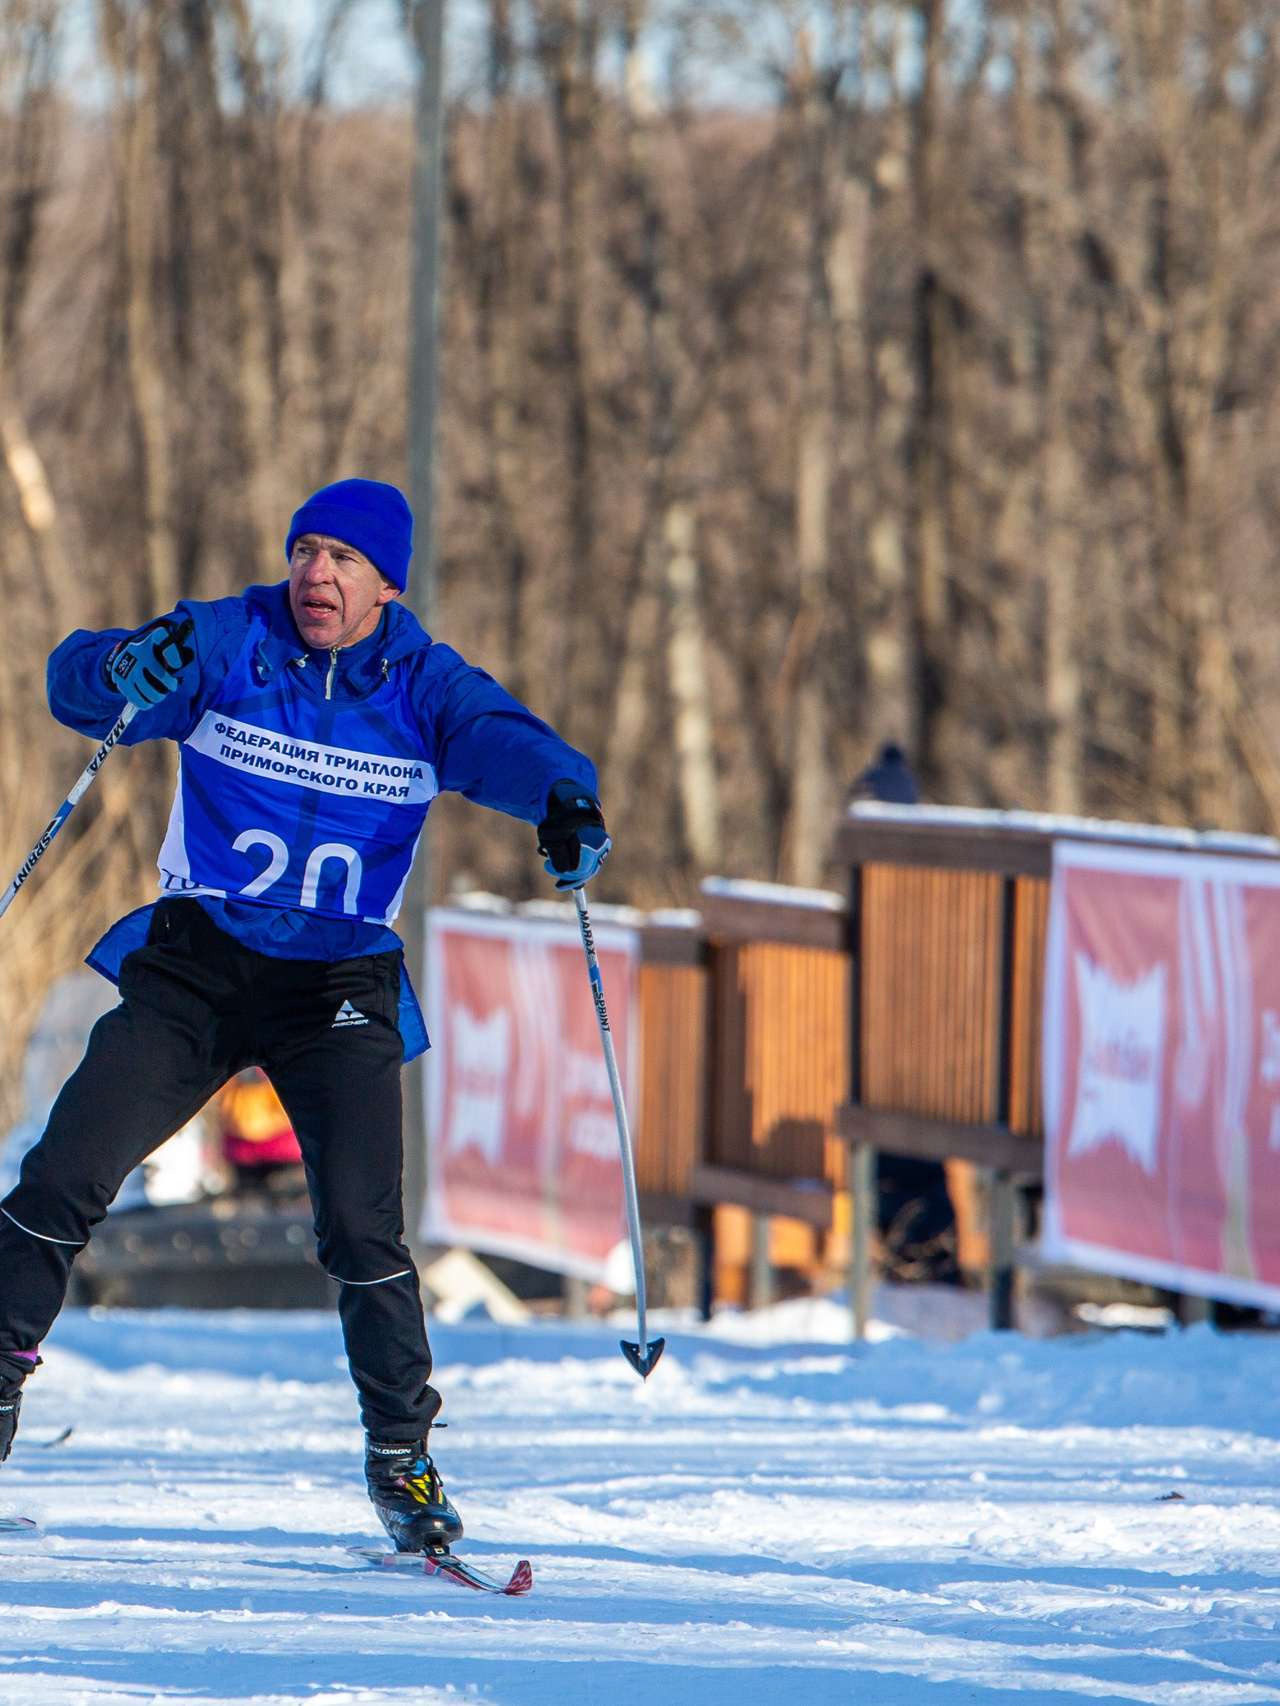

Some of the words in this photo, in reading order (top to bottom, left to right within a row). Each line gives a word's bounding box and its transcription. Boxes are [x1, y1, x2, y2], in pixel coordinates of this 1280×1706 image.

[214, 722, 320, 763] ФЕДЕРАЦИЯ
[324, 753, 424, 780] ТРИАТЛОНА
[219, 744, 358, 791] ПРИМОРСКОГО
[363, 781, 410, 798] КРАЯ
[12, 834, 52, 894] SPRINT
[231, 828, 363, 915] 20
[579, 909, 596, 956] MARAX
[594, 992, 611, 1033] SPRINT
[369, 1445, 412, 1455] SALOMON
